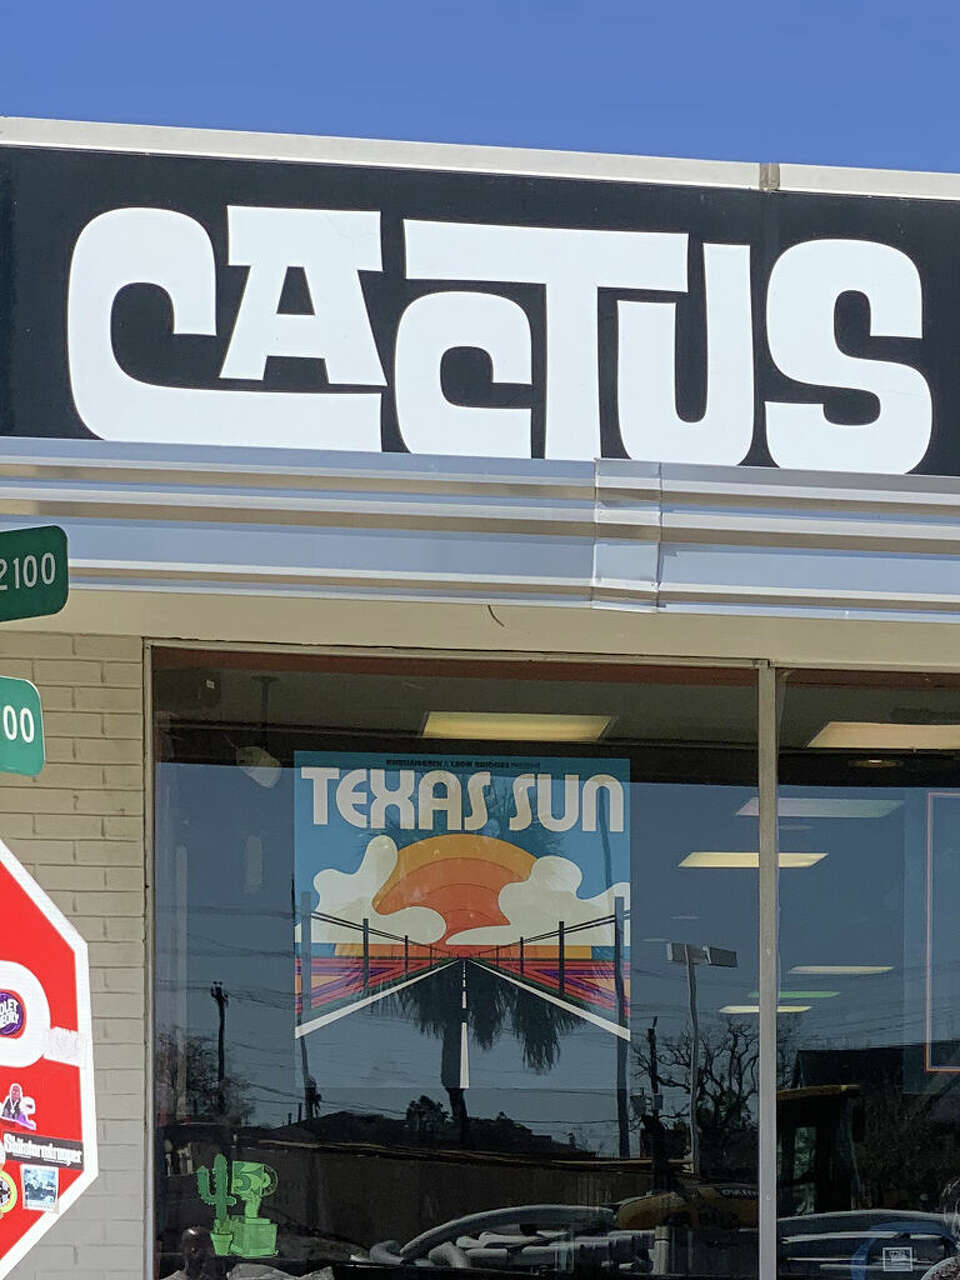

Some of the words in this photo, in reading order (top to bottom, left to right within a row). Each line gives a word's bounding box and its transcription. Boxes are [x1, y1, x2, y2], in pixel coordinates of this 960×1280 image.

[67, 205, 933, 475] CACTUS
[301, 767, 491, 831] TEXAS
[509, 773, 625, 833] SUN
